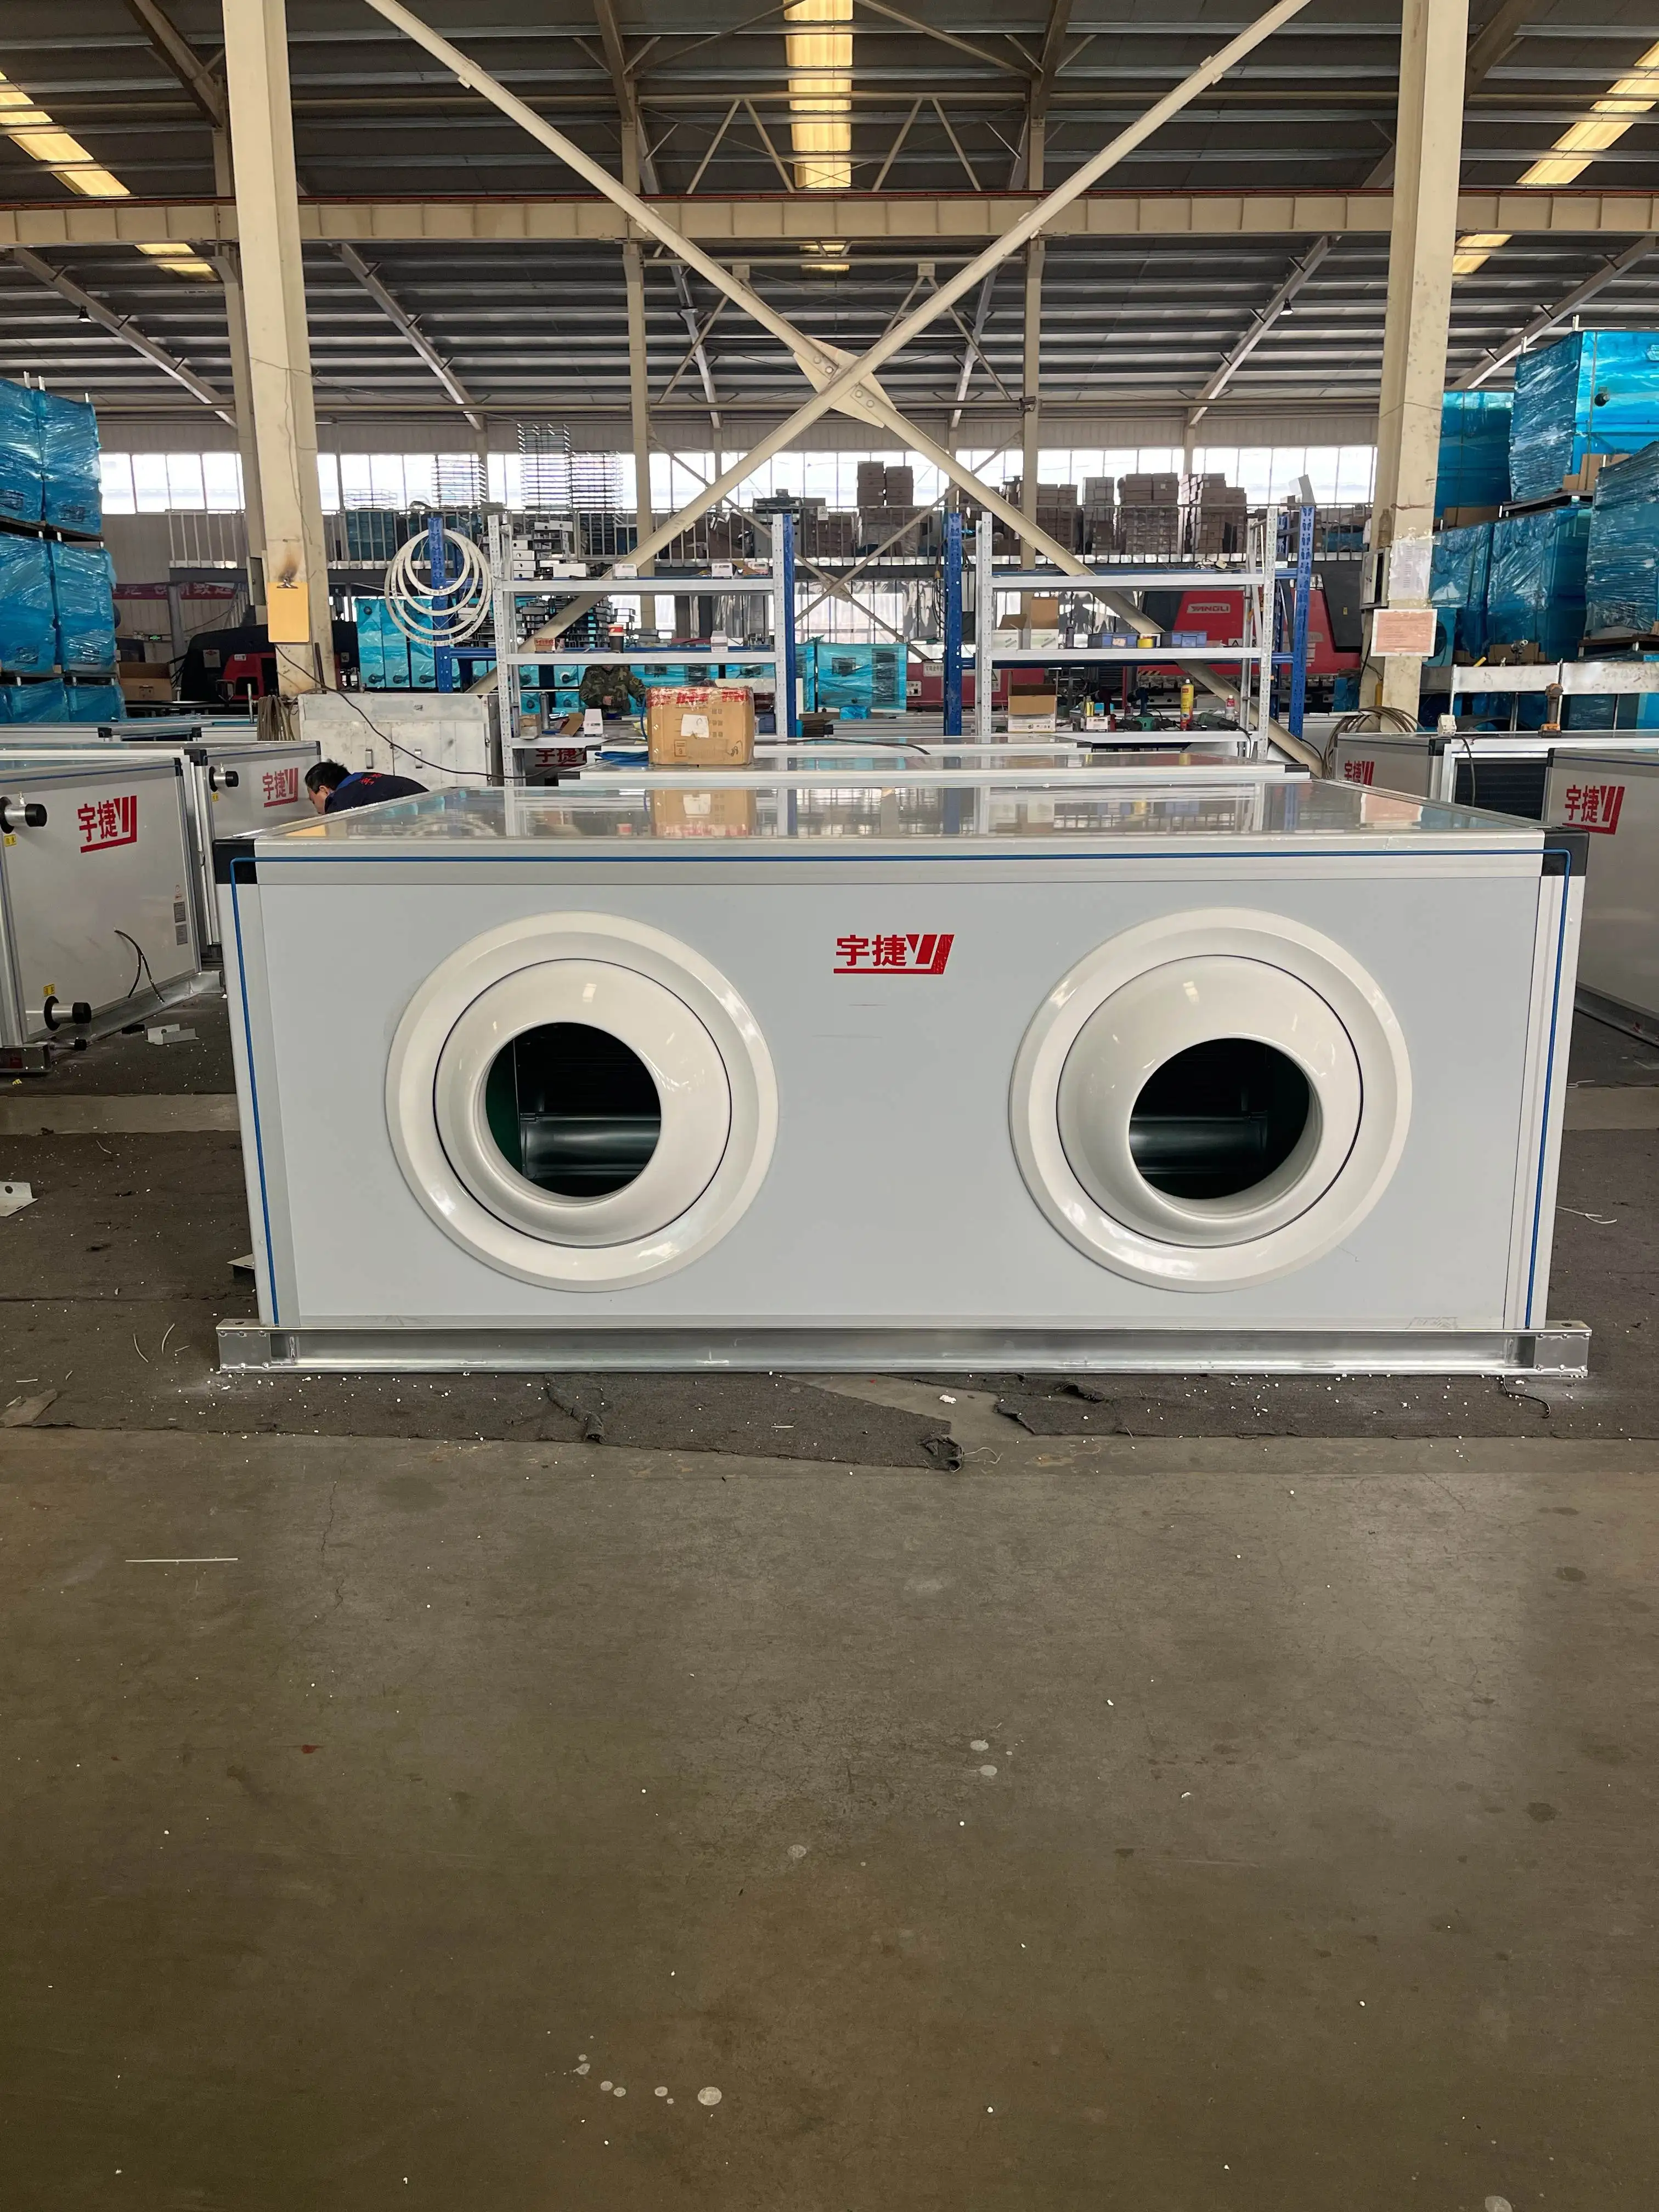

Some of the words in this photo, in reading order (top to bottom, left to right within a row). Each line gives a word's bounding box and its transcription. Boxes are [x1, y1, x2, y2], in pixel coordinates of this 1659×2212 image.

[262, 770, 286, 800] 宇捷
[78, 800, 118, 842] 宇捷
[1565, 785, 1600, 823] 宇捷
[836, 934, 907, 966] 宇捷
